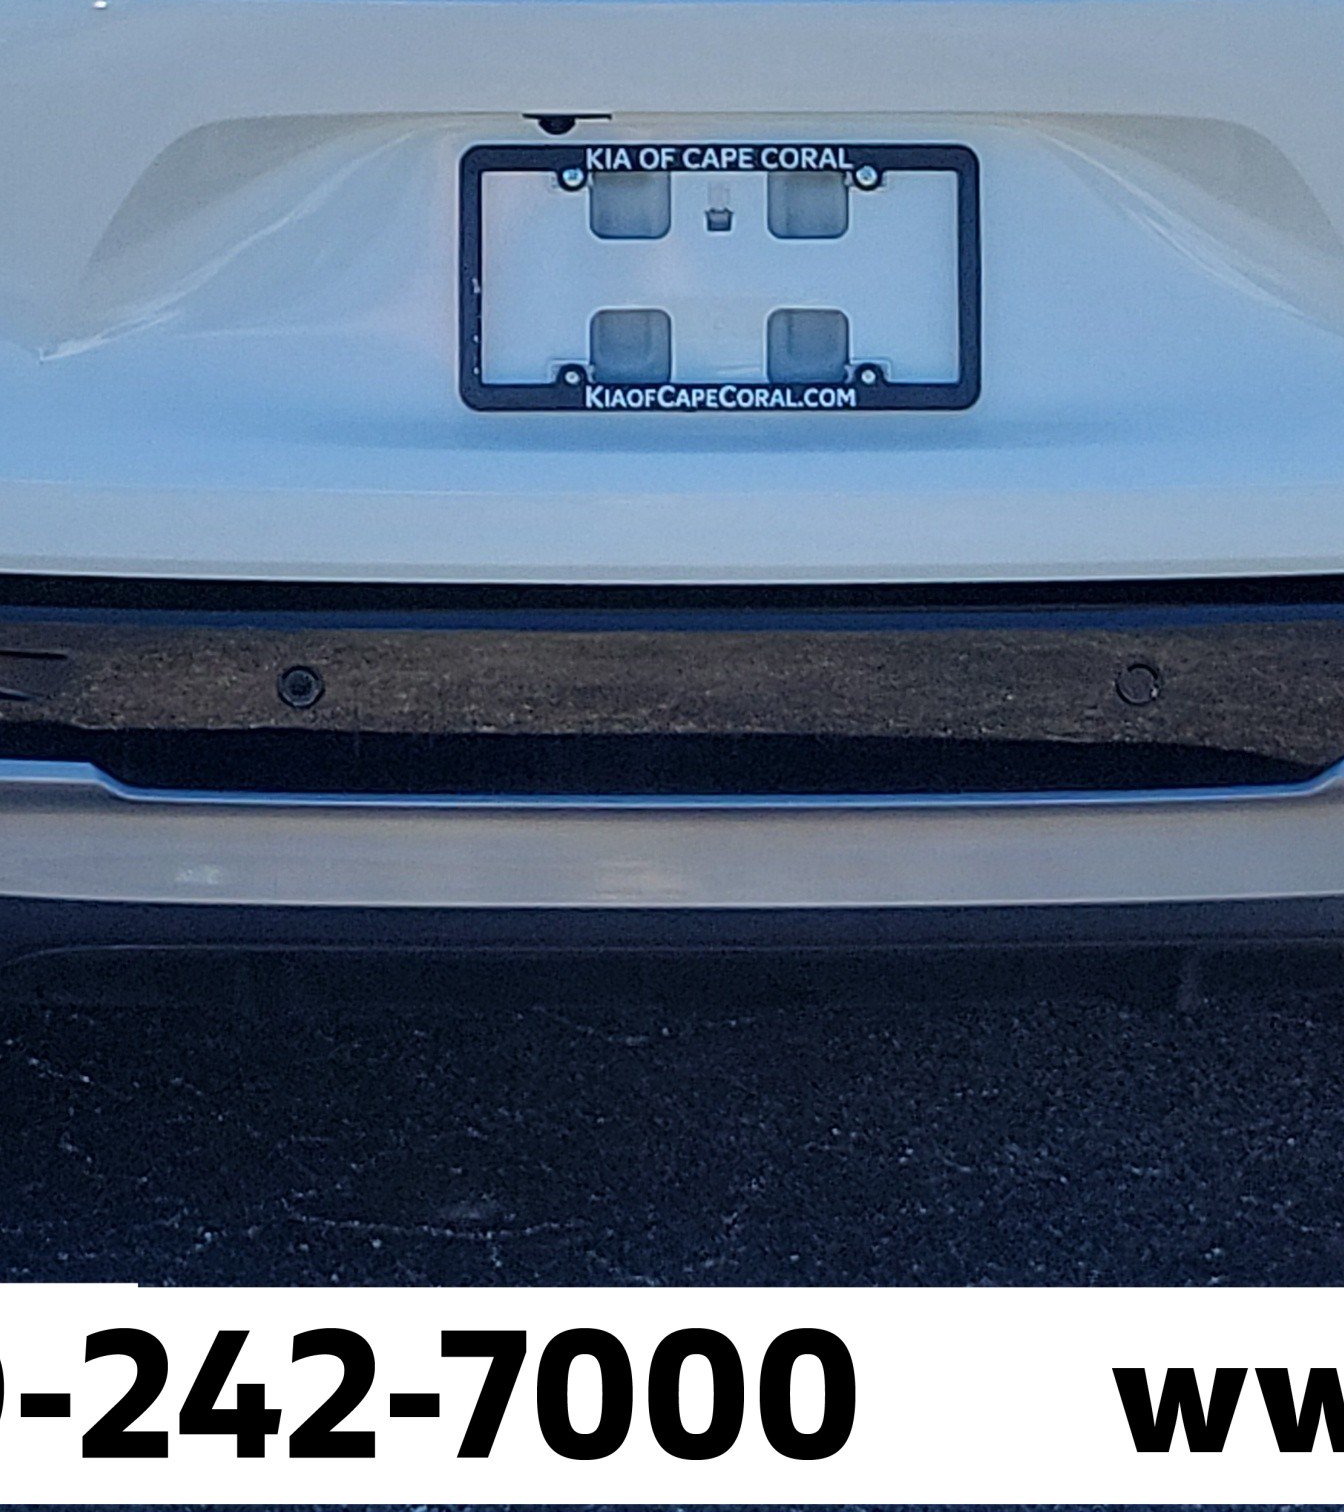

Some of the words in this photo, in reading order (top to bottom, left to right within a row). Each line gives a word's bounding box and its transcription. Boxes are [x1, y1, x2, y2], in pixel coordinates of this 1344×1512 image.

[585, 147, 633, 170] KIA
[638, 147, 678, 170] OF
[682, 147, 755, 170] CAPE
[760, 147, 854, 170] CORAL
